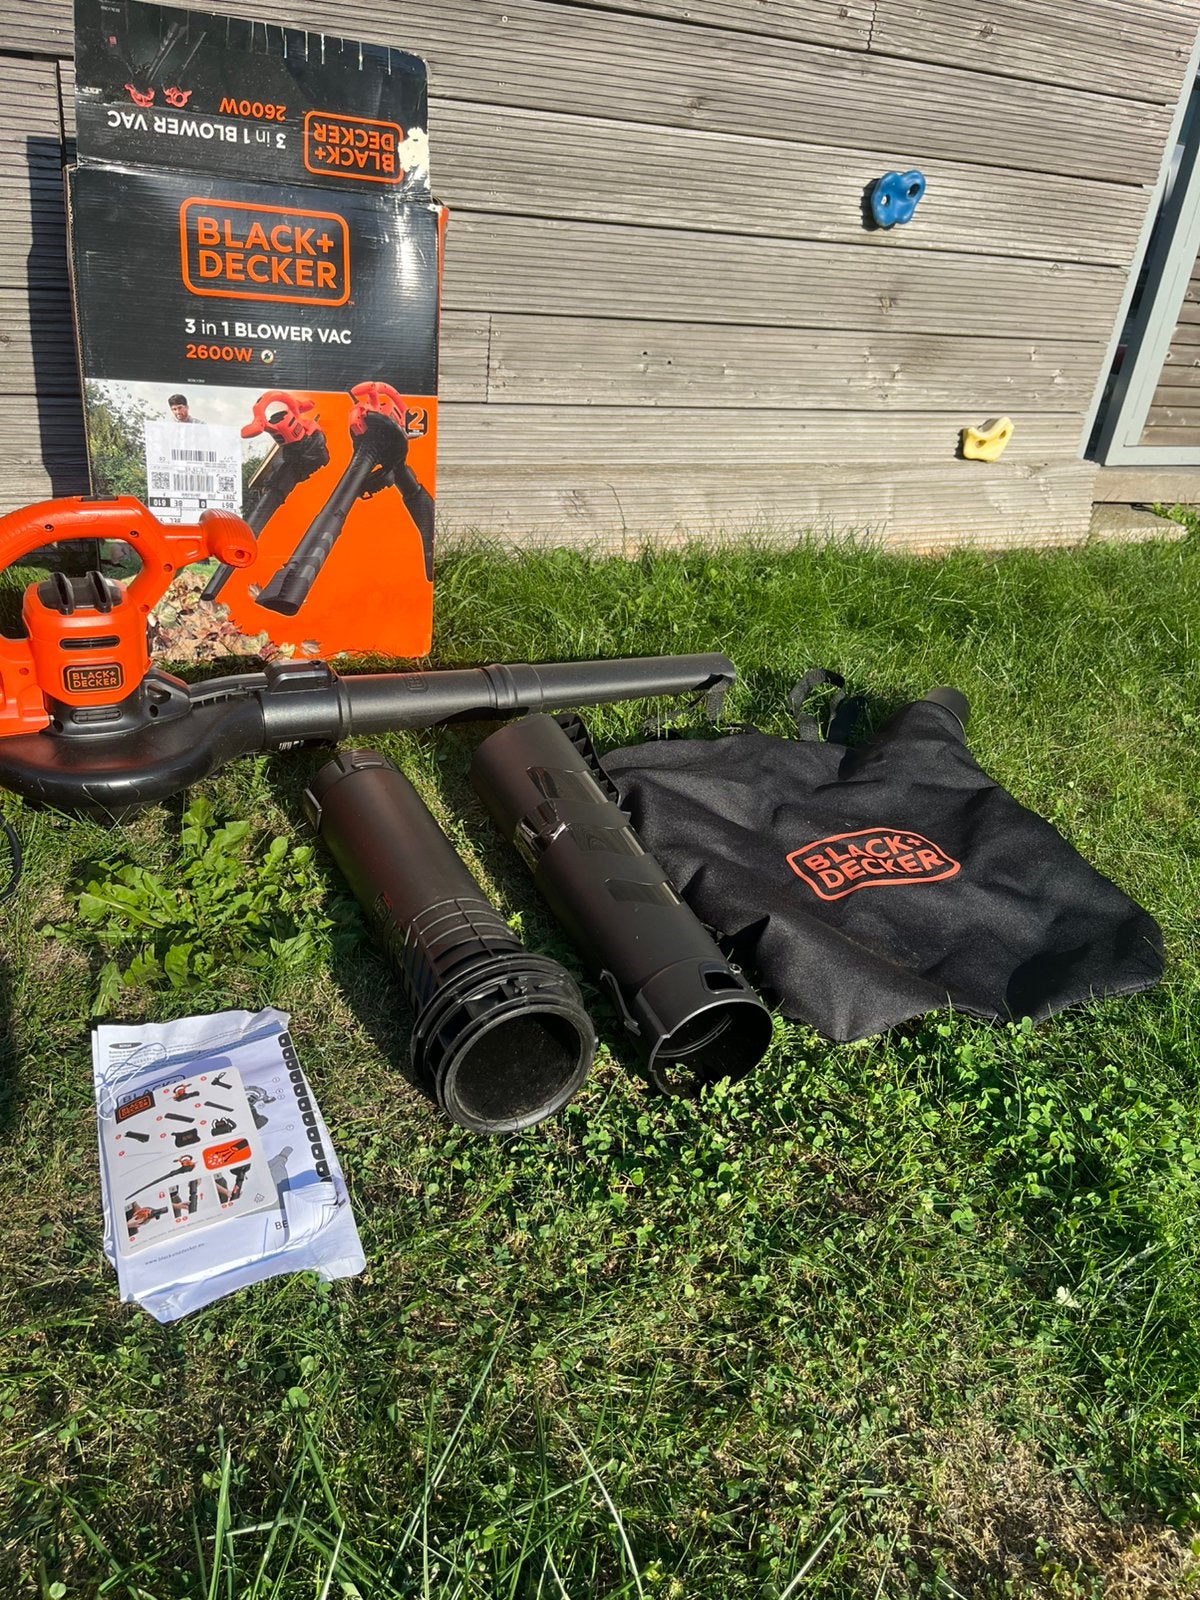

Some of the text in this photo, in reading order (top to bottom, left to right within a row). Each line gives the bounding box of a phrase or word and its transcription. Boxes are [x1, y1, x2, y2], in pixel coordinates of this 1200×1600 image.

[219, 97, 287, 122] 2600W
[107, 110, 287, 149] 3 in 1 BLOWER VAC
[313, 122, 395, 152] DECKER
[314, 145, 395, 173] BLACK+
[197, 216, 335, 256] BLACK+
[199, 249, 337, 289] DECKER
[184, 318, 352, 345] 3 in 1 BLOWER VAC
[186, 343, 253, 362] 2600W
[408, 406, 425, 430] 2
[72, 670, 116, 680] BLACK+
[73, 677, 117, 688] DECKER
[803, 835, 923, 872] BLACK+
[817, 849, 945, 889] DECKER
